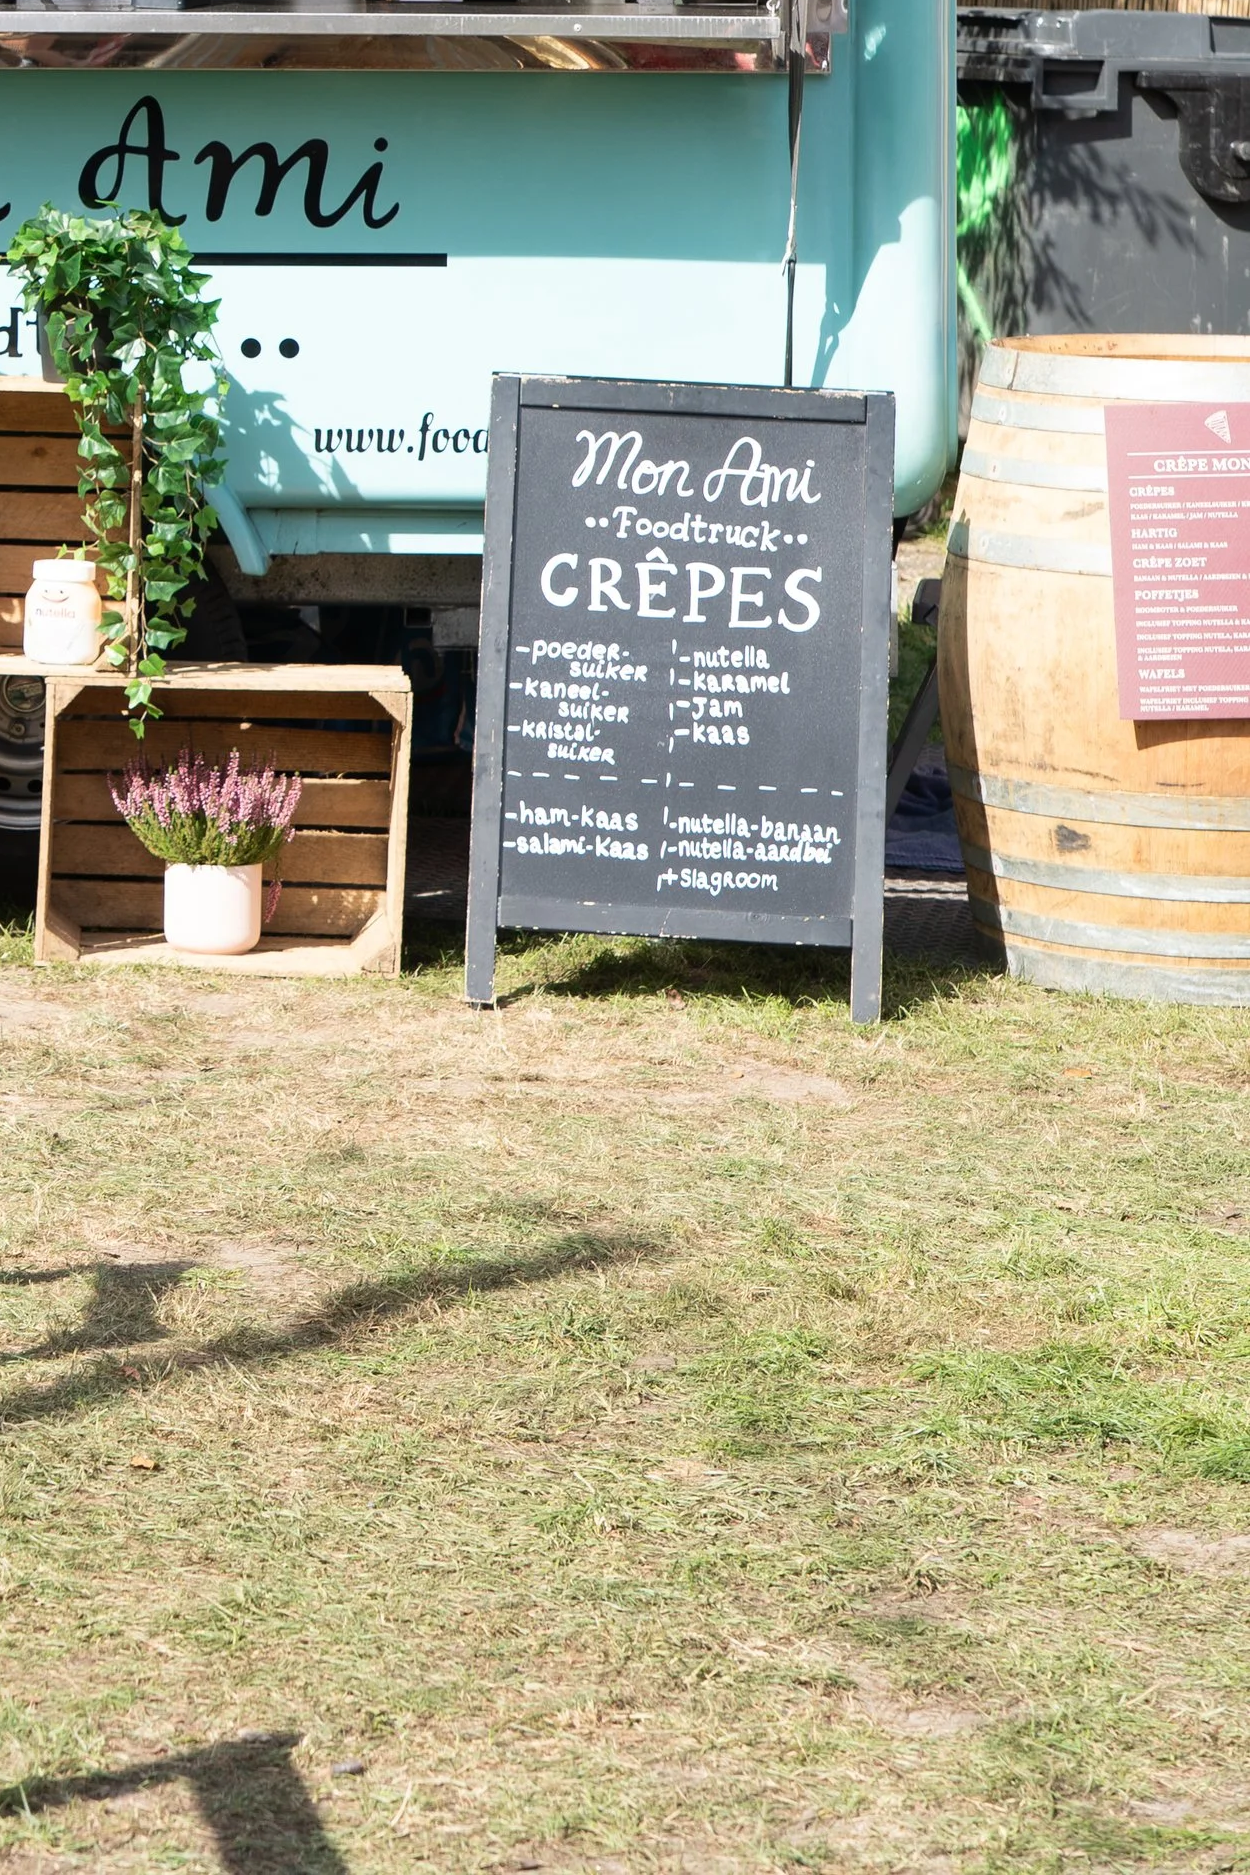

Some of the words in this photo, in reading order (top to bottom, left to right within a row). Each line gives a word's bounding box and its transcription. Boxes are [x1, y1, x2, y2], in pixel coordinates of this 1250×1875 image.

[78, 95, 399, 228] Ami
[571, 429, 695, 496] Mon
[703, 436, 822, 508] Ami
[1153, 455, 1209, 472] CRÊPE
[1212, 457, 1250, 471] MON
[1129, 485, 1175, 497] CRÊPES
[1189, 512, 1203, 520] JAM
[1131, 528, 1178, 538] HARTIG
[1133, 556, 1173, 568] CRÊPE
[1174, 557, 1207, 567] ZOET
[540, 546, 823, 633] CRÊPES
[1134, 589, 1199, 602] POFFETJES
[1138, 668, 1186, 679] WAFELS
